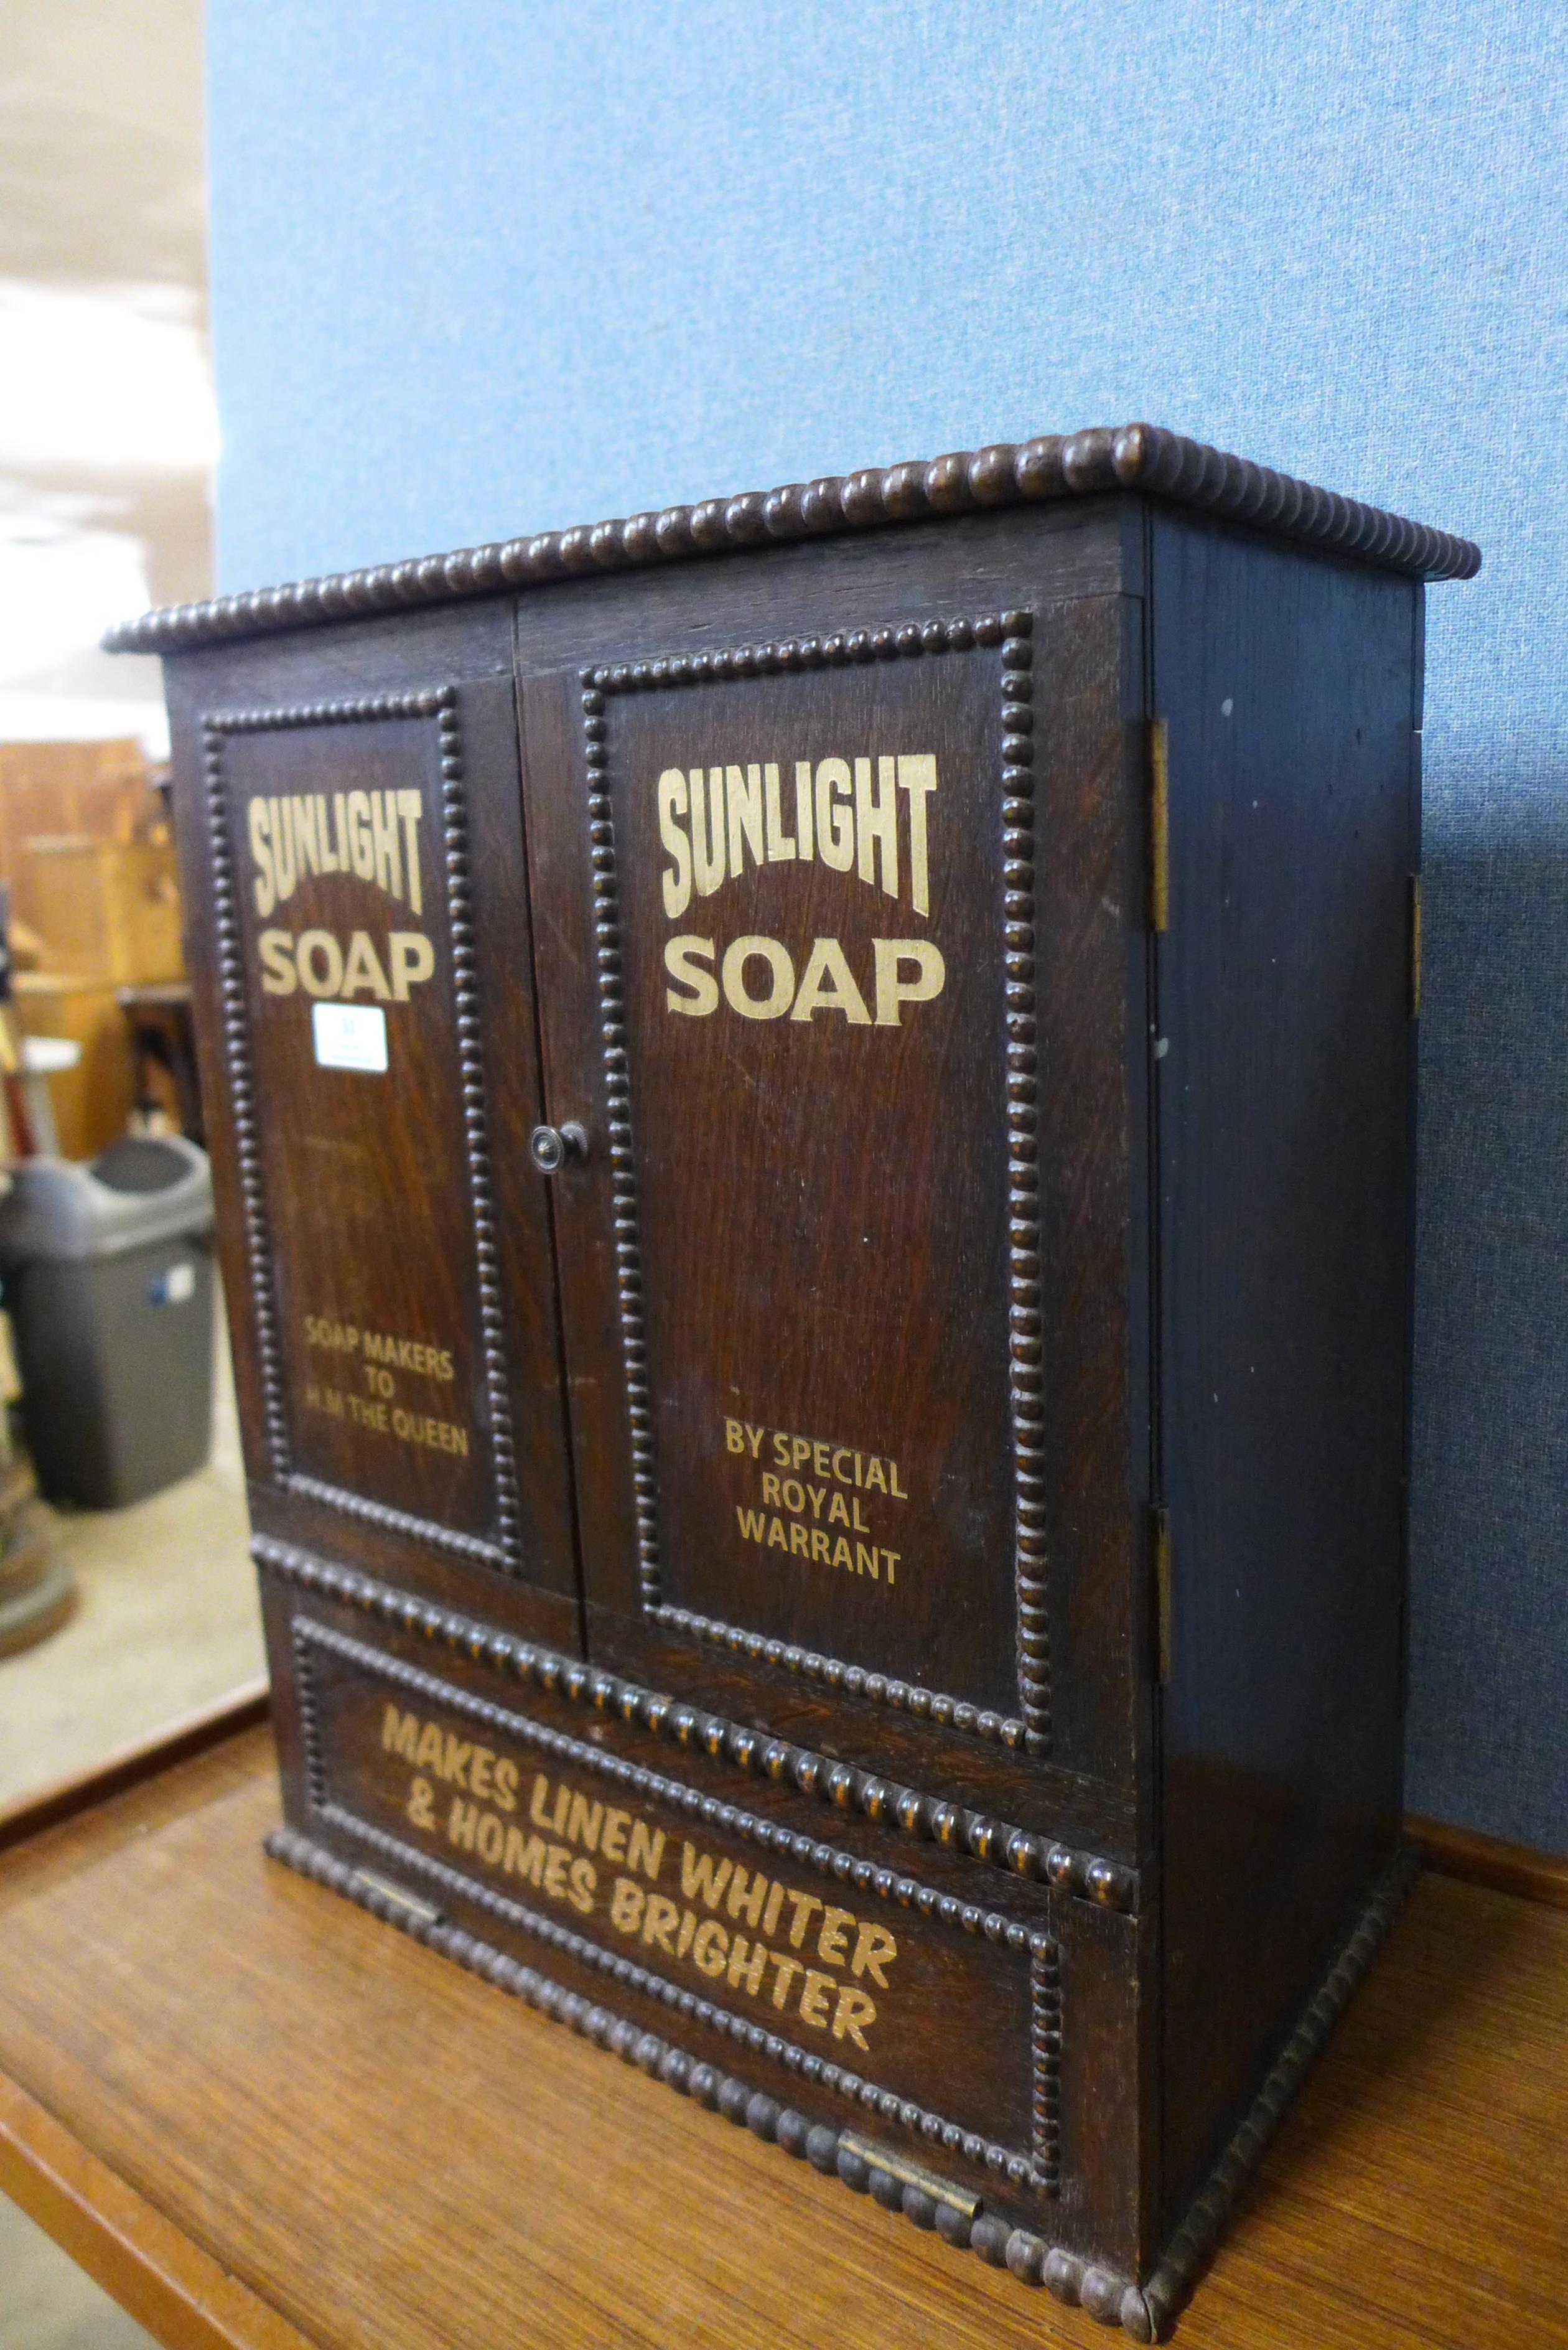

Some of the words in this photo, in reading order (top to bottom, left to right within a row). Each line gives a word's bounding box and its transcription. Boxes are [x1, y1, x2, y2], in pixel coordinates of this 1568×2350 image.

[250, 789, 422, 918] SUNLIGHT
[658, 754, 937, 918] SUNLIGHT
[258, 928, 435, 1001] SOAP
[664, 934, 946, 1026] SOAP
[305, 1315, 360, 1354] SOAP
[363, 1331, 454, 1382] MAKERS
[364, 1365, 395, 1399] TO
[347, 1394, 390, 1432] THE
[393, 1408, 469, 1457] QUEEN
[726, 1419, 764, 1459] BY
[773, 1433, 908, 1499] SPECIAL
[762, 1471, 870, 1533] ROYAL
[736, 1505, 901, 1585] WARRANT
[381, 1703, 519, 1812] MAKES
[530, 1773, 666, 1880] LINEN
[681, 1840, 898, 1990] WHITER
[406, 1776, 437, 1832] &
[448, 1797, 597, 1914] HOMES
[610, 1876, 878, 2051] BRIGHTER
